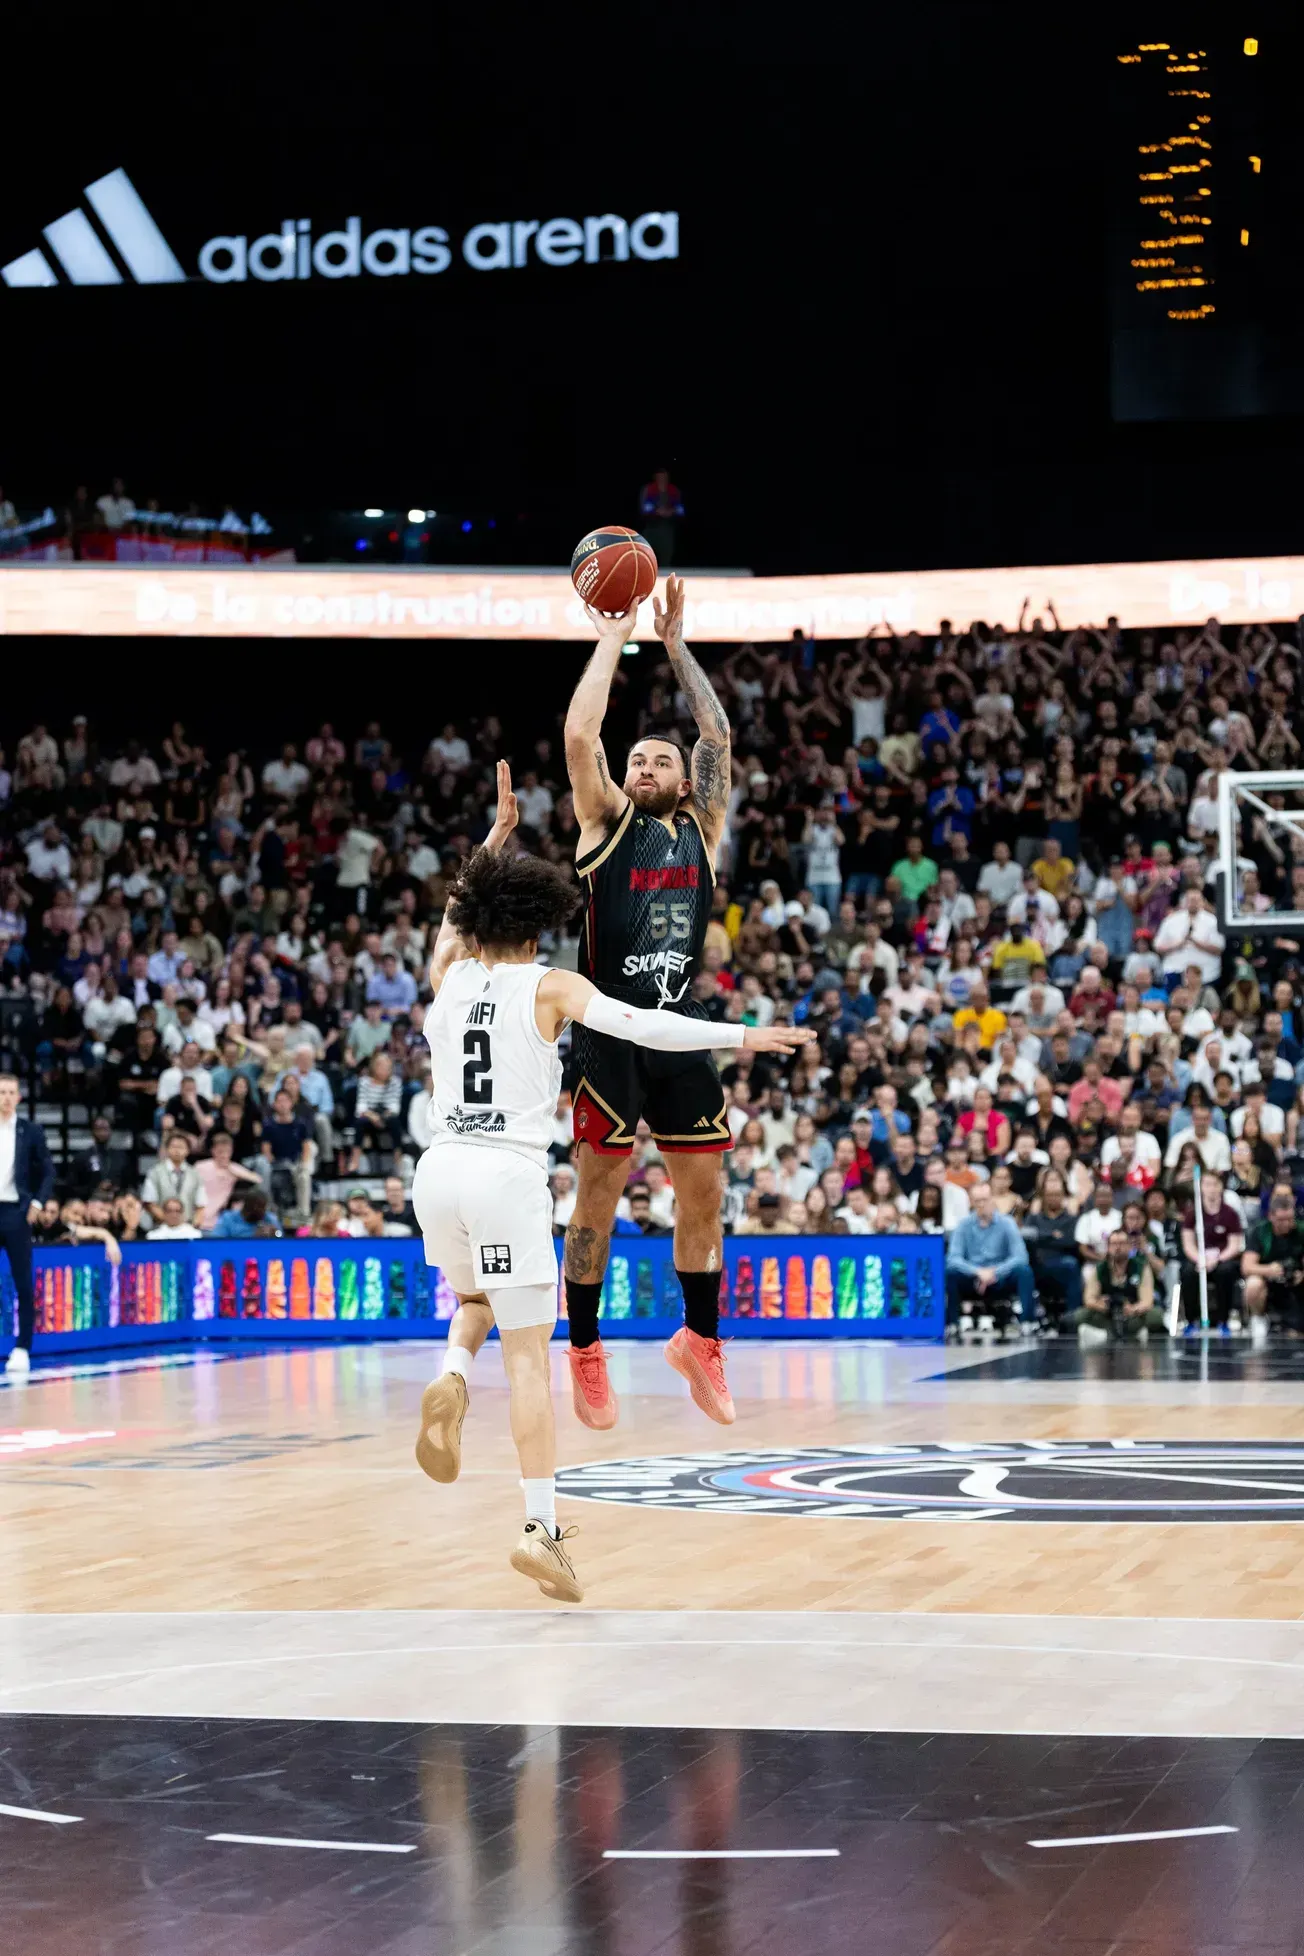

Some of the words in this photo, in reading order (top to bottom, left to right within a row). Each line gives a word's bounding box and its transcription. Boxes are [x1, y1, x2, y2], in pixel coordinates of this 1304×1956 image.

[198, 215, 452, 283] adidas
[462, 211, 680, 271] arena
[650, 902, 690, 940] 55
[463, 1029, 493, 1105] 2
[483, 1246, 509, 1259] BE
[590, 1488, 1016, 1521] PARIS
